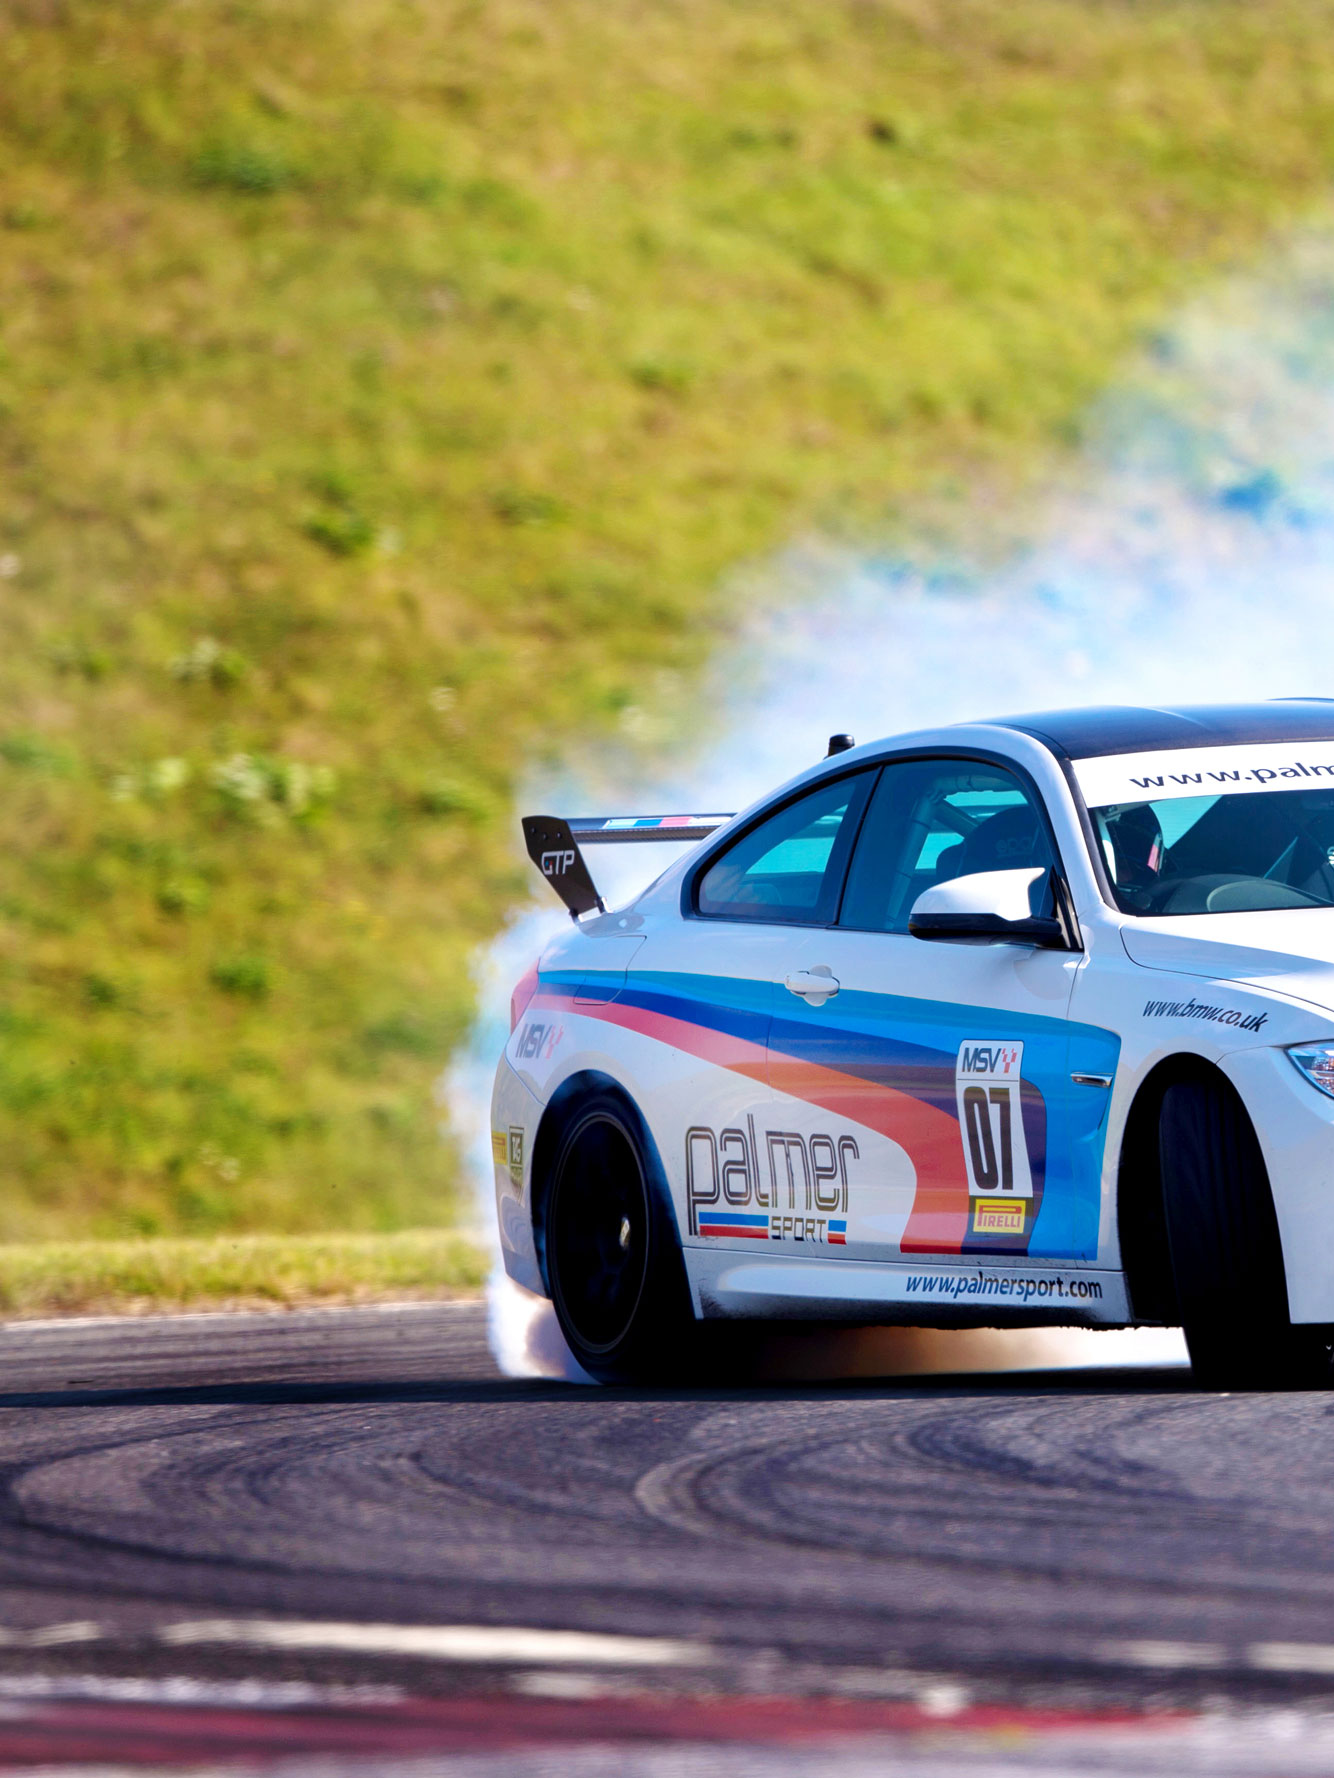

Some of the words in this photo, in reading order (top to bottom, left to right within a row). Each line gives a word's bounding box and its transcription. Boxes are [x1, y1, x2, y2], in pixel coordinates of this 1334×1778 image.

[541, 849, 575, 875] GTP
[1142, 998, 1268, 1032] www.bmw.co.uk
[515, 1023, 552, 1059] MSV
[961, 1047, 1001, 1073] MSV
[963, 1086, 1014, 1190] 07
[686, 1113, 860, 1236] palmer
[771, 1216, 827, 1243] SPORT
[976, 1205, 1022, 1229] PIRELLI
[906, 1270, 1103, 1302] www.palmersport.com
